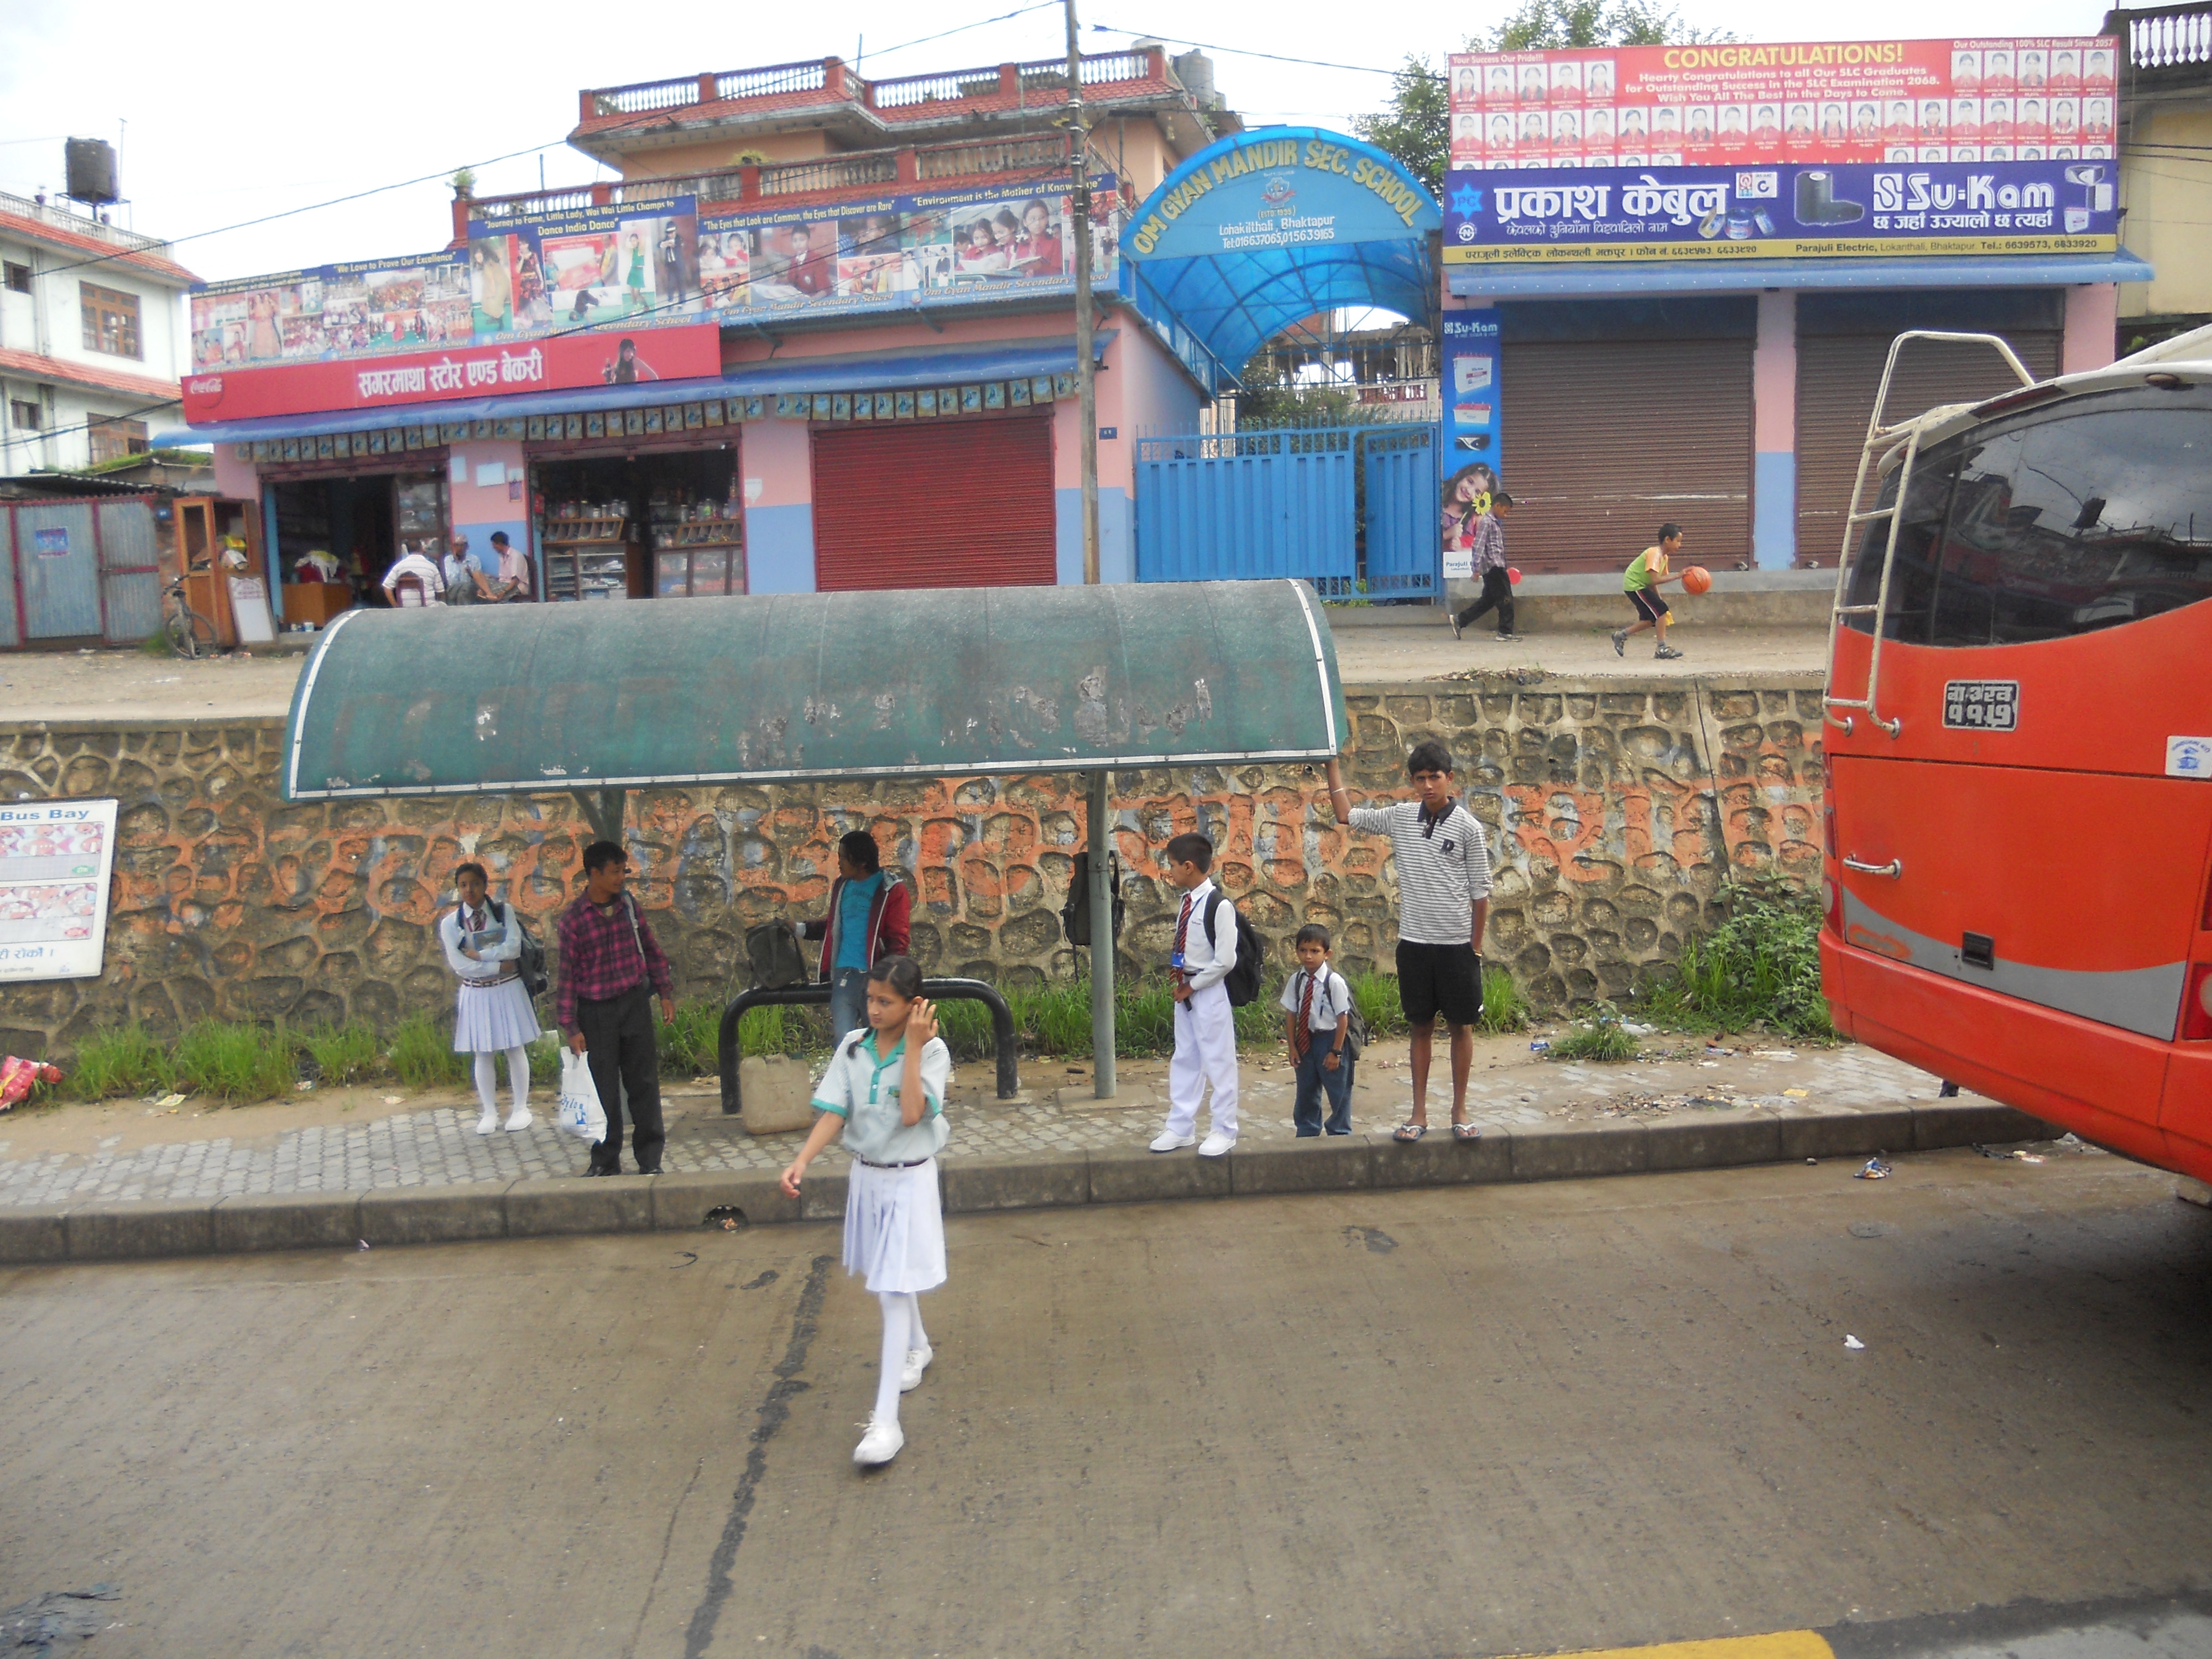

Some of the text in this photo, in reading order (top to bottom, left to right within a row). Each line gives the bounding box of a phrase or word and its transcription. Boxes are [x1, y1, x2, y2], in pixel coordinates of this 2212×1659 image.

[1969, 40, 2013, 49] Outstanding
[2052, 39, 2073, 48] Result
[2075, 39, 2093, 47] Since
[1472, 55, 1499, 63] Success
[1501, 54, 1515, 62] Our
[1517, 54, 1543, 62] Pride!!!
[1664, 44, 1903, 69] CONGRATULATIONS!
[1625, 76, 1939, 93] for Outstanding Success in the SLC Examination 2068.
[1640, 74, 1678, 83] Hearty
[1682, 71, 1776, 82] Congratulations
[1795, 69, 1809, 77] all
[1839, 68, 1860, 77] SLC
[1864, 67, 1926, 76] Graduates
[1658, 93, 1686, 102] Wish
[1690, 92, 1710, 101] You
[1714, 92, 1729, 101] All
[1733, 91, 1754, 100] The
[1757, 90, 1783, 100] Best
[1801, 89, 1819, 97] the
[1824, 88, 1852, 99] Days
[1856, 88, 1867, 97] to
[1871, 88, 1907, 97] Come.
[912, 194, 973, 207] "Environment
[975, 191, 983, 201] is
[985, 191, 999, 200] the
[1001, 187, 1034, 199] Mother
[1036, 185, 1046, 194] of
[1134, 140, 1423, 254] OM GYAN MANDIR SEC. SCHOOL
[1457, 196, 1476, 207] PC
[1494, 175, 1730, 226] प्रकाश केबुल
[1907, 173, 2054, 210] Su-Kam
[484, 200, 675, 229] "Journey to Fame, Little Lady, Wai Wai Little Champs to
[719, 219, 732, 229] Eyes
[733, 217, 745, 228] that
[747, 215, 761, 226] Look
[763, 216, 773, 225] are
[774, 212, 802, 223] Common,
[802, 211, 813, 220] the
[813, 208, 827, 220] Eyes
[828, 207, 839, 217] that
[841, 205, 865, 216] Discover
[866, 204, 877, 212] are
[1281, 216, 1335, 230] Bhaktapur
[1873, 209, 2054, 230] छ जहाँ उज्यालो छ त्यहाँ
[538, 217, 619, 236] Dance India Dance"
[1648, 222, 1668, 233] नाम
[1465, 248, 1499, 260] पराजुली
[1596, 247, 1625, 258] भक्तपुर
[1636, 246, 1656, 257] फोन
[1796, 243, 1833, 253] Parajuli
[1837, 243, 1877, 252] Electric,
[1880, 242, 1928, 252] Lokanthali,
[2005, 241, 2051, 249] 6639573,
[351, 263, 367, 272] Love
[369, 261, 376, 270] to
[378, 259, 399, 268] Prove
[401, 257, 414, 265] Our
[416, 251, 456, 264] Excellence"
[923, 288, 942, 297] Om
[944, 286, 971, 296] Gyan
[974, 281, 1013, 293] Mandir
[1015, 276, 1071, 289] Secondary
[722, 307, 740, 316] Om
[743, 305, 767, 315] Gyan
[770, 300, 806, 312] Mandir
[808, 296, 859, 308] Secondary
[861, 292, 894, 302] School
[495, 332, 514, 341] Om
[517, 329, 545, 340] Gyan
[655, 315, 692, 325] School
[1454, 322, 1498, 333] Su-Kam
[359, 347, 543, 398] सगरमाथा स्टोर एण्ड बेकरी
[1, 809, 90, 821] Bus Bay
